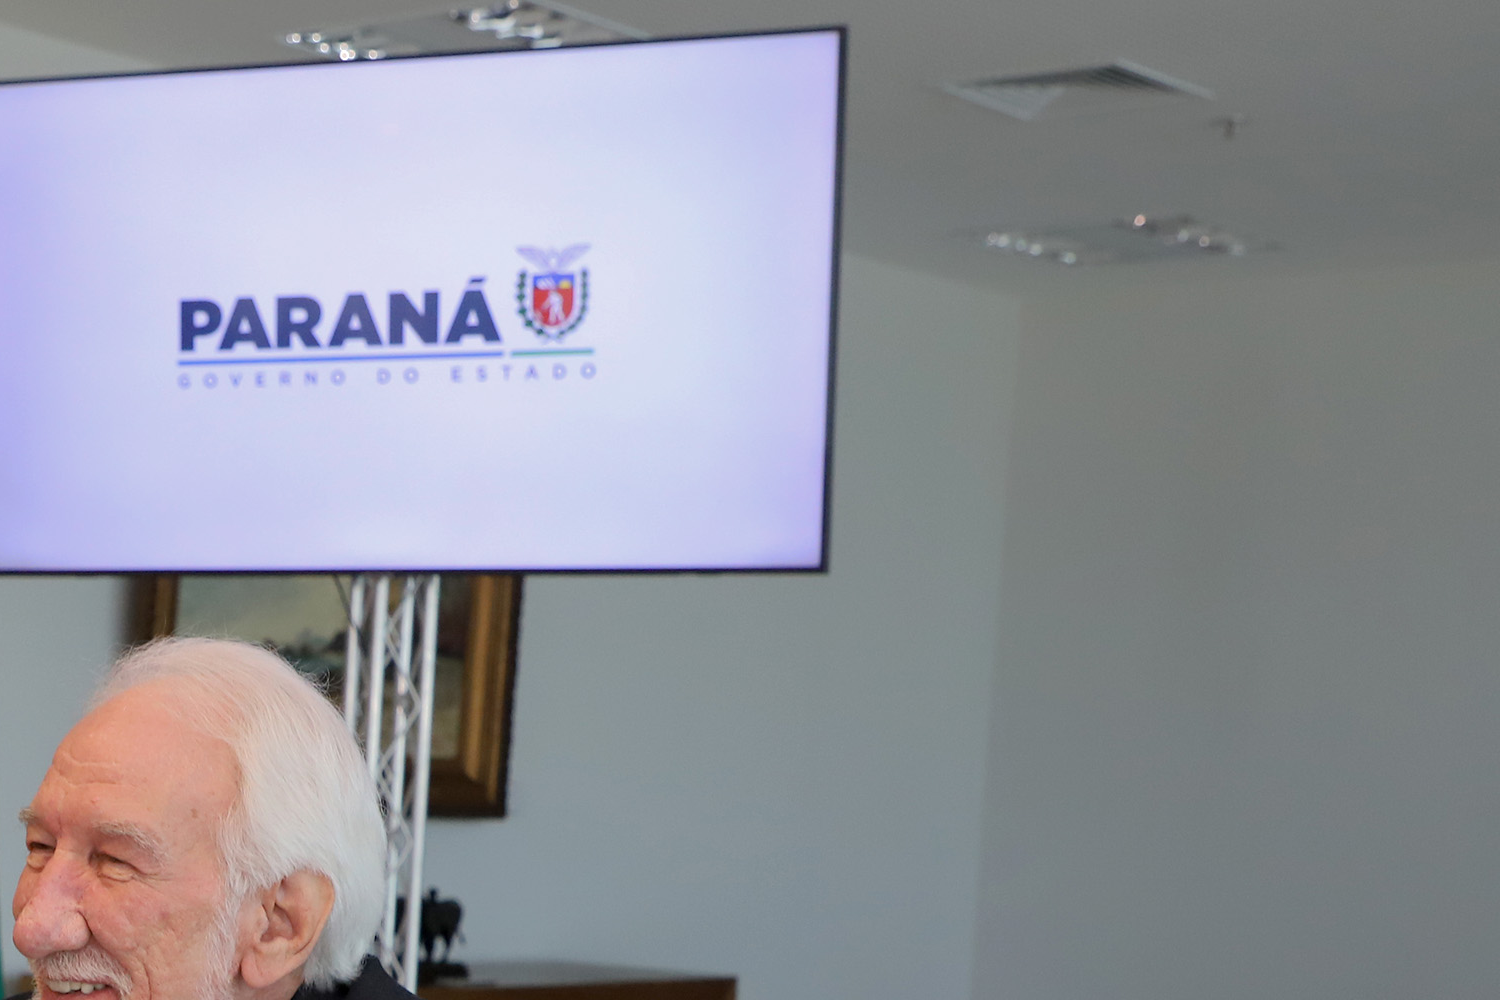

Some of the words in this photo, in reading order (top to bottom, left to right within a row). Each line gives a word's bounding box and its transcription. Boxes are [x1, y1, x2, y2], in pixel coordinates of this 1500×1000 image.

[180, 277, 501, 351] PARANÁ
[178, 369, 346, 389] GOVERNO
[377, 366, 421, 384] DO
[450, 362, 597, 383] ESTADO
